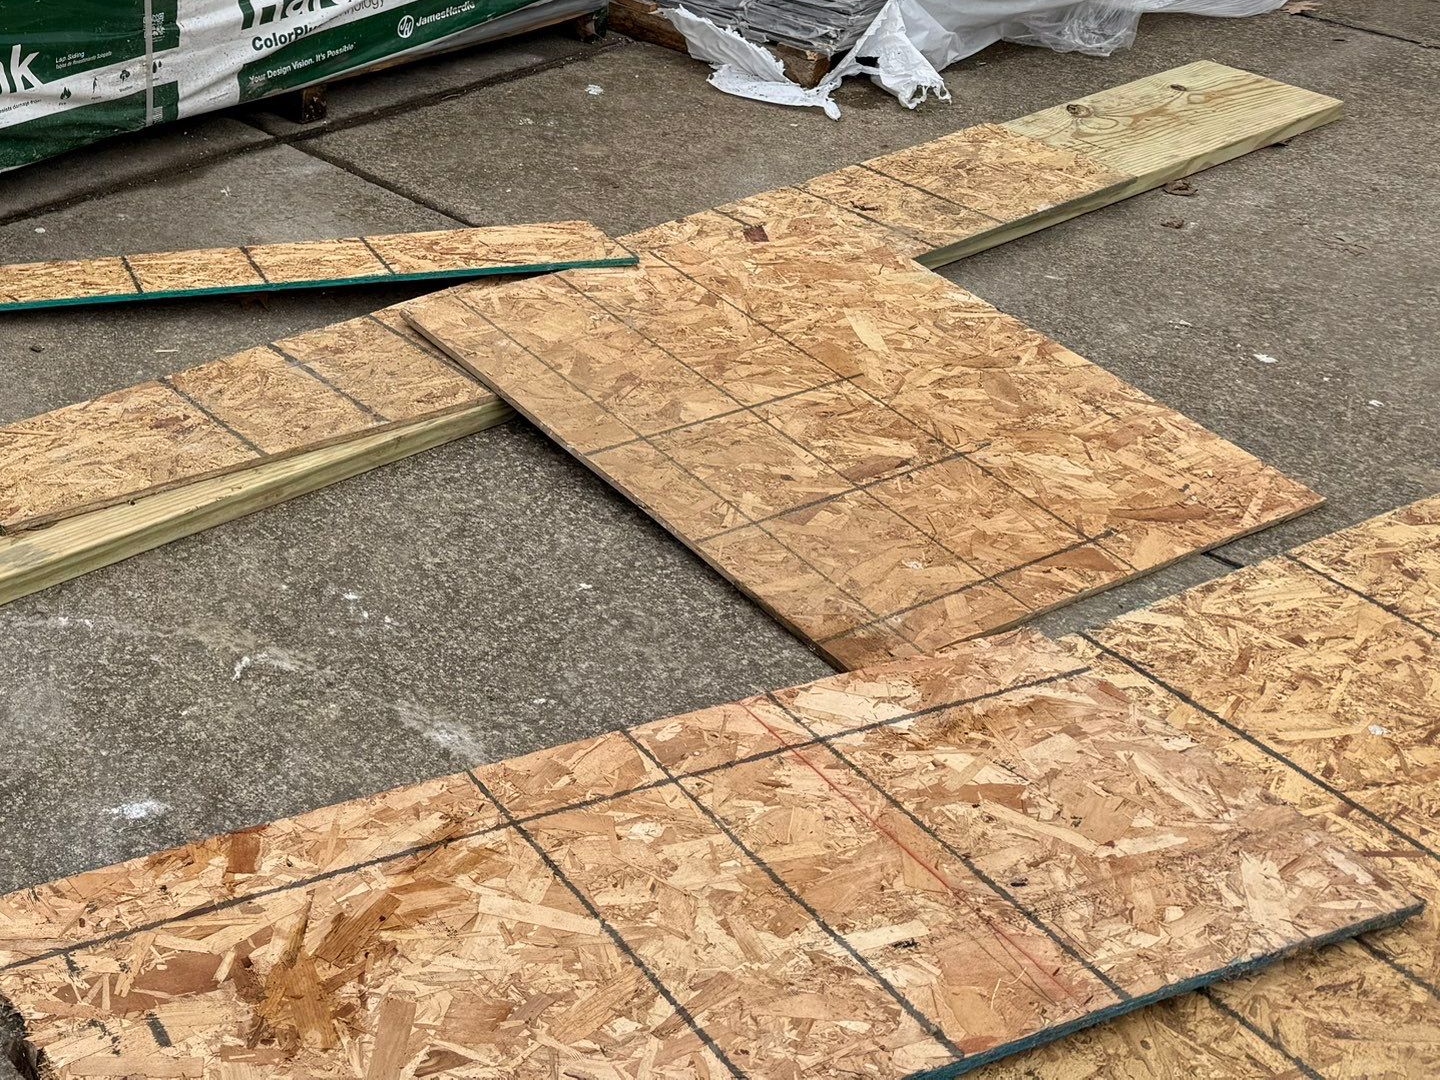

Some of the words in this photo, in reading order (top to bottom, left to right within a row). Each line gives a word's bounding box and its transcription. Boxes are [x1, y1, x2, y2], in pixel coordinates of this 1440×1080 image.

[416, 1, 476, 27] JamesHardie
[67, 52, 85, 60] Siding
[249, 73, 266, 84] Your
[267, 65, 291, 79] Design
[291, 58, 314, 70] Vision.
[315, 53, 325, 62] It's
[327, 43, 354, 58] Possible
